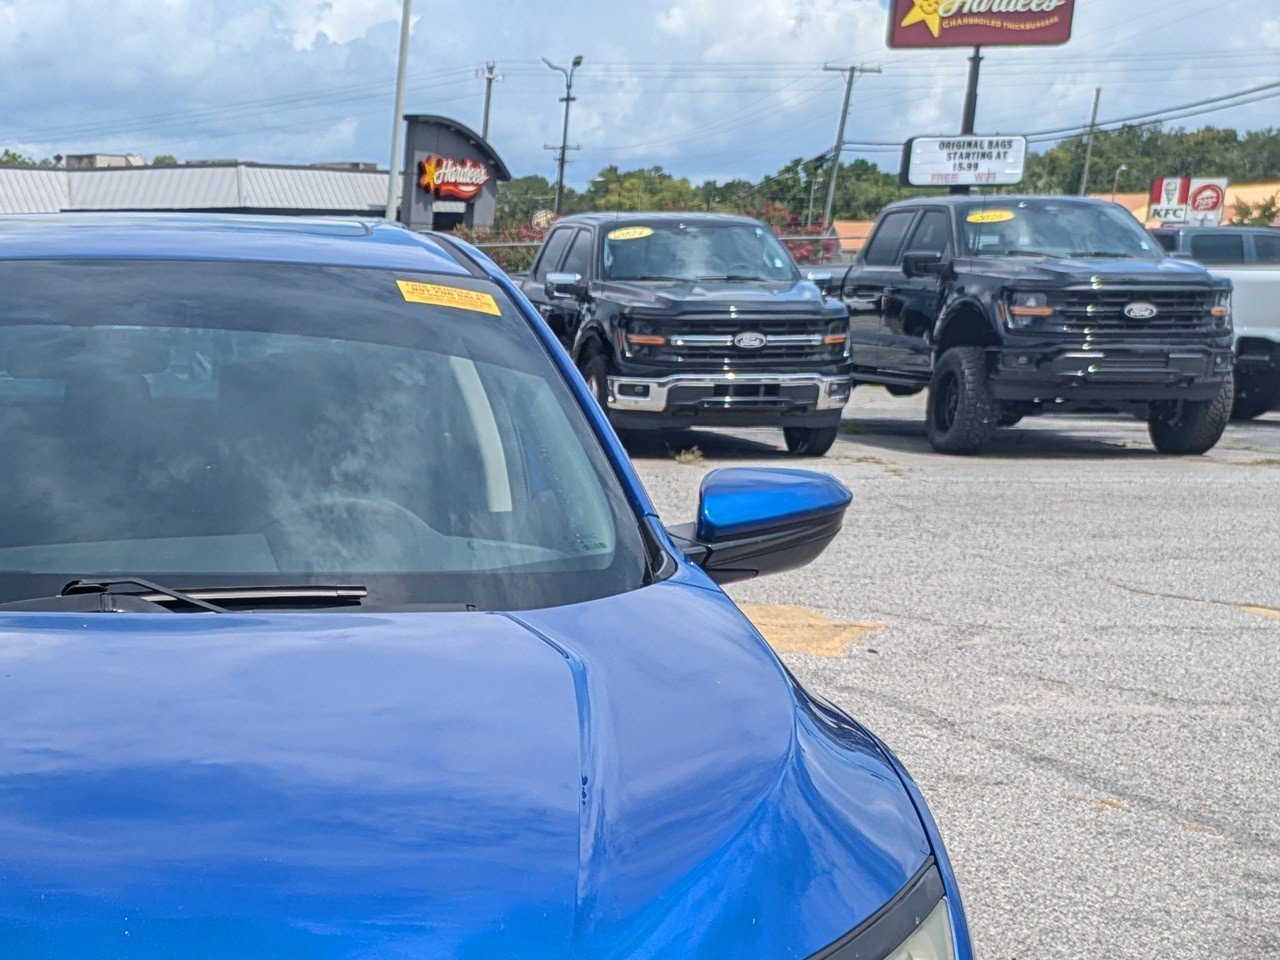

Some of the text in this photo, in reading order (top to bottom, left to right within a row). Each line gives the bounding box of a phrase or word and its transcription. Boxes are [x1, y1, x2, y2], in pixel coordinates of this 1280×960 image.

[939, 140, 1013, 150] ORIGINAL BAGS
[947, 151, 1008, 161] STARTING AT
[930, 173, 958, 183] FREE
[1152, 208, 1184, 218] KFC
